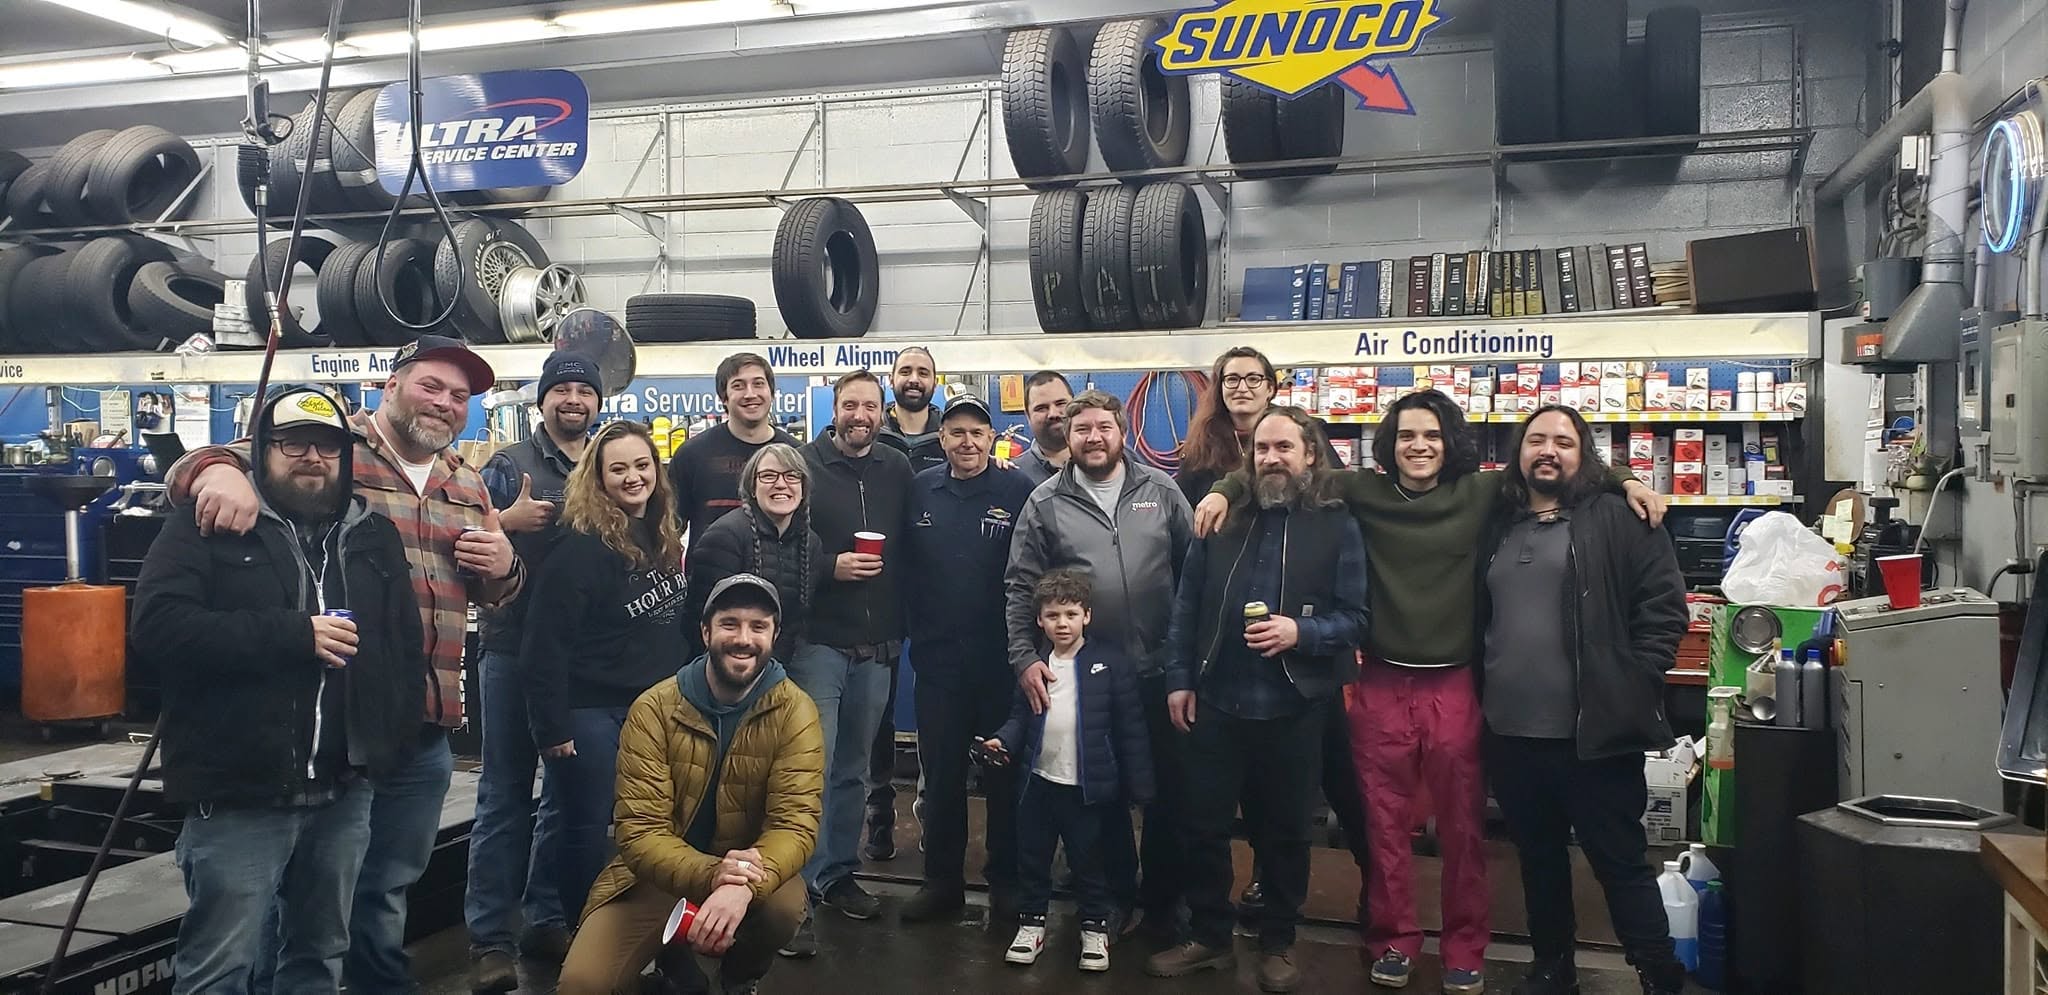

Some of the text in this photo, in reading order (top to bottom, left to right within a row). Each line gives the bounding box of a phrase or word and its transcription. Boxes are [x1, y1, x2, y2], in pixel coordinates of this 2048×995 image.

[1170, 3, 1416, 63] SUNOCO
[380, 115, 538, 152] ULTRA
[418, 142, 578, 164] ERVICE CENTER
[768, 344, 928, 371] Wheel Alignm
[1354, 328, 1554, 359] Air Conditioning
[311, 353, 360, 378] Engine
[644, 386, 725, 413] Service
[624, 579, 674, 619] HOUR
